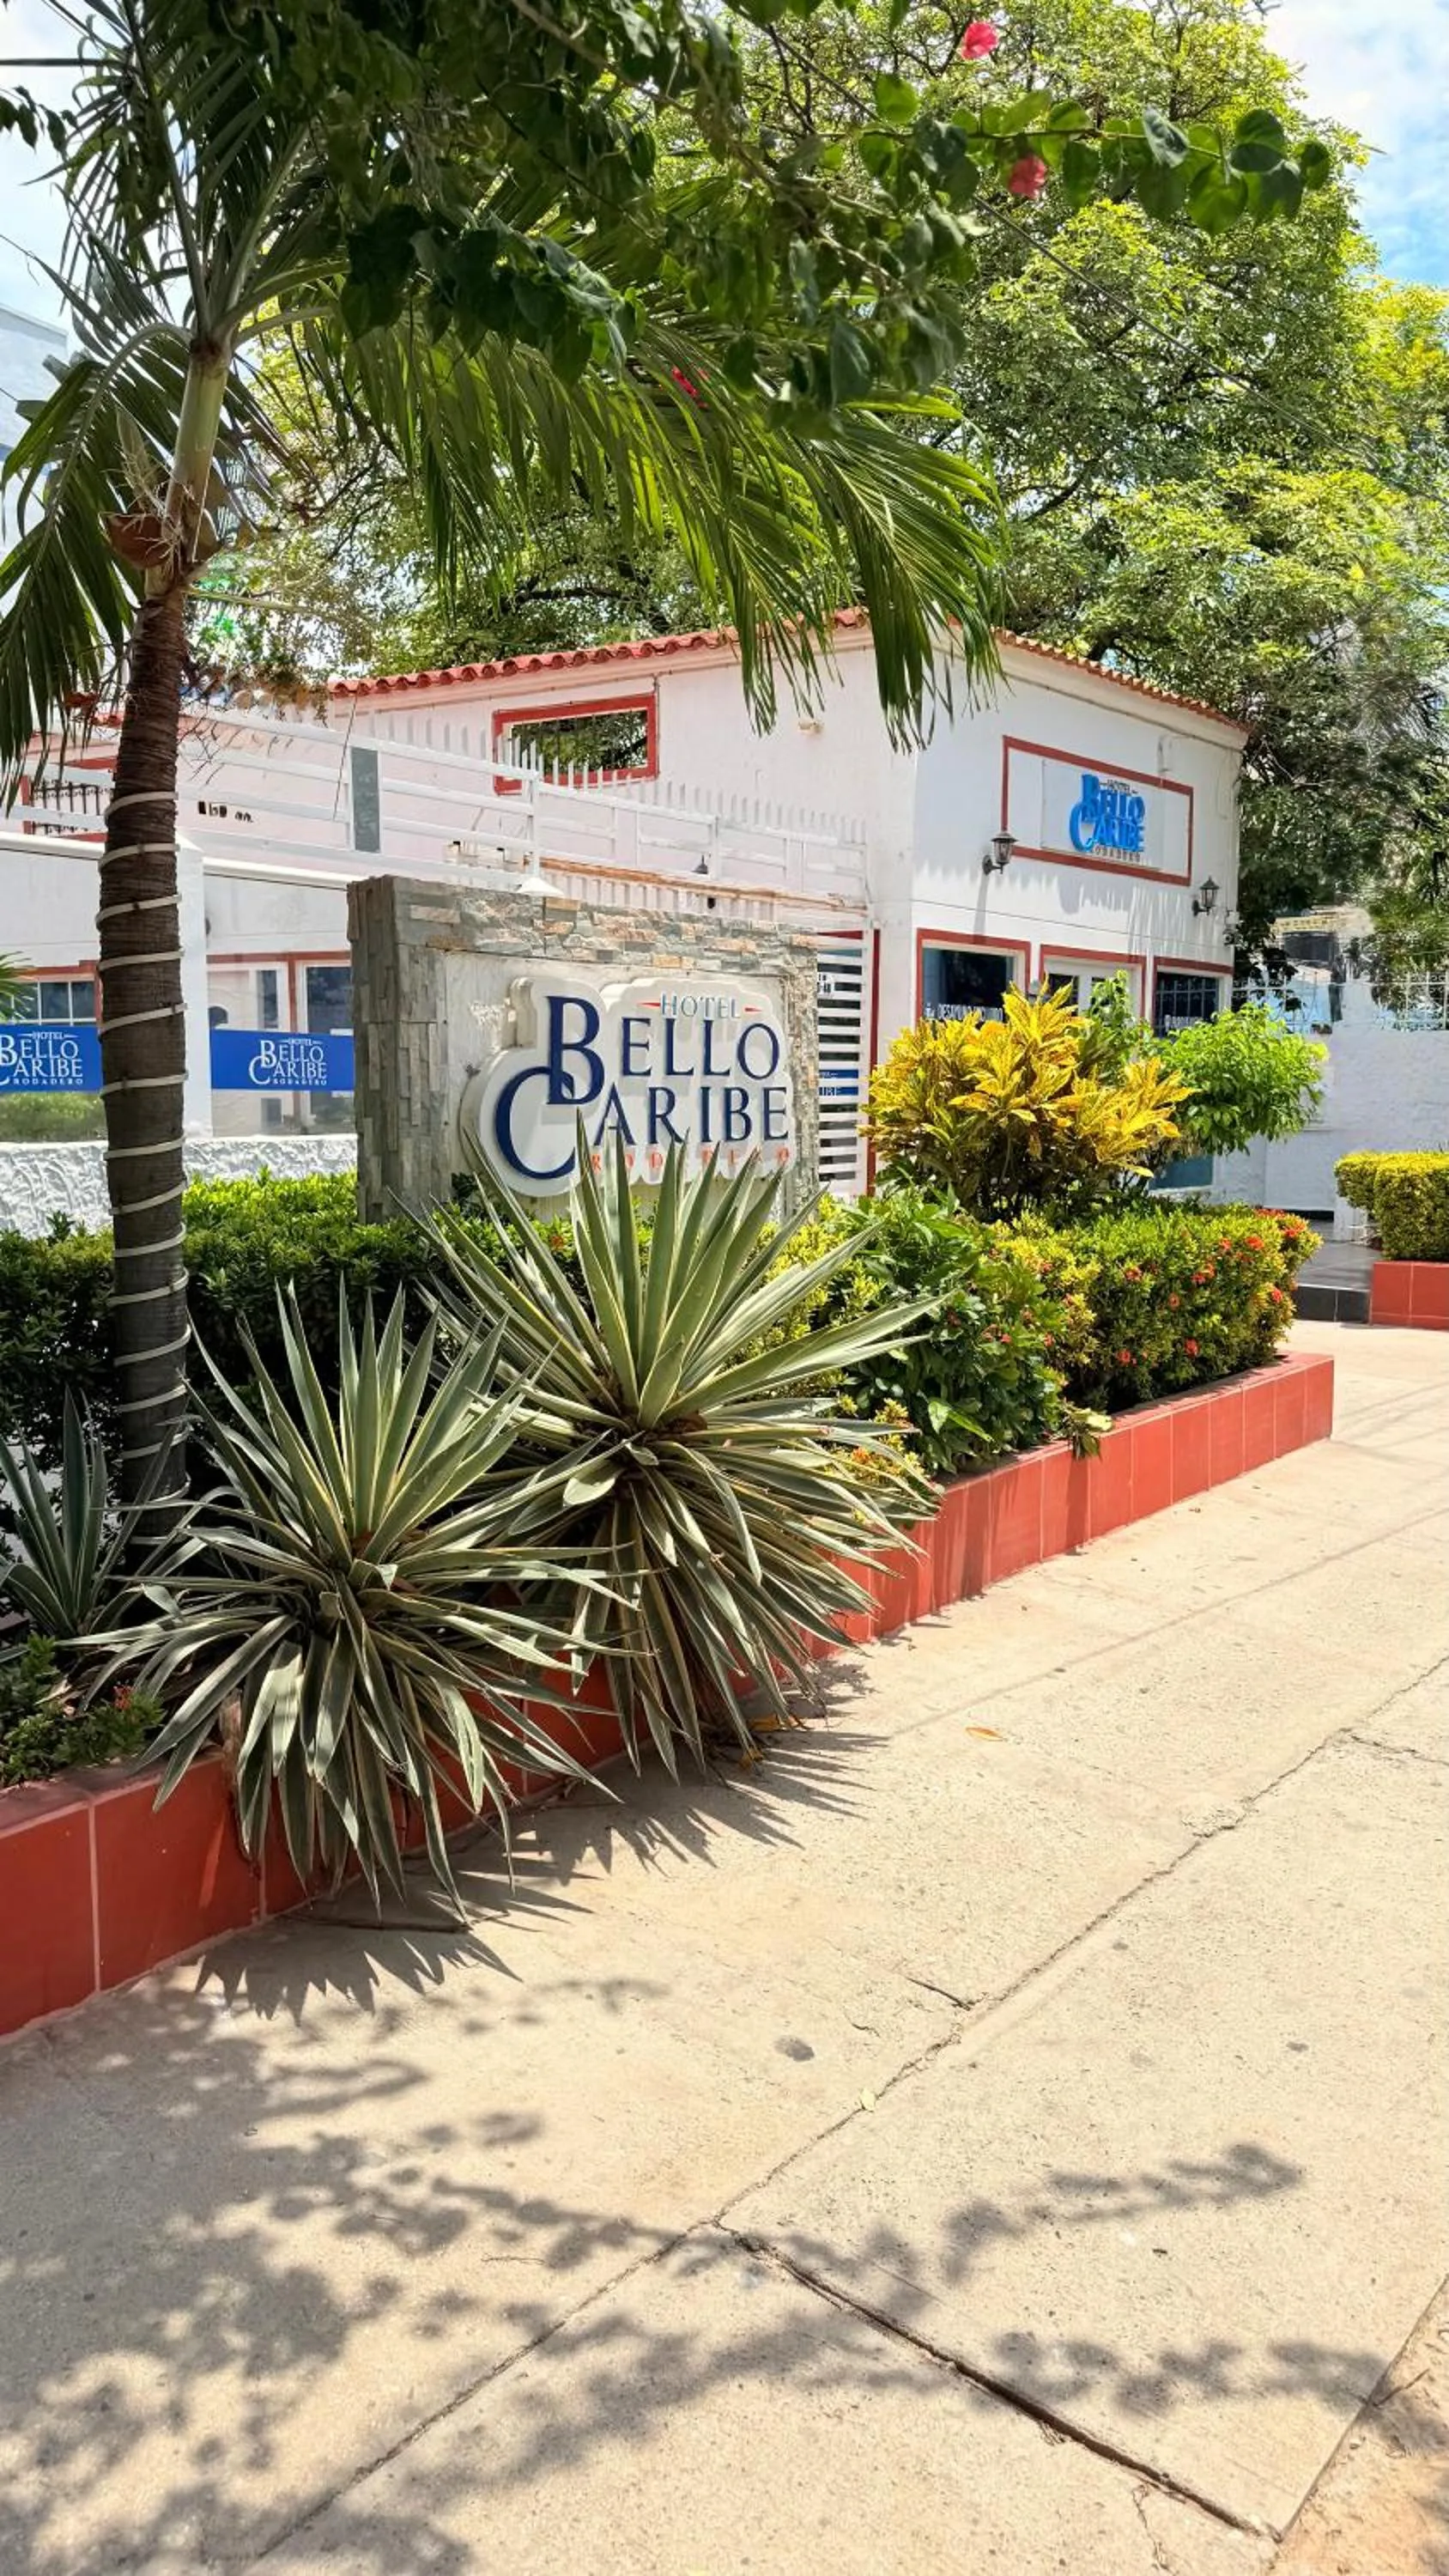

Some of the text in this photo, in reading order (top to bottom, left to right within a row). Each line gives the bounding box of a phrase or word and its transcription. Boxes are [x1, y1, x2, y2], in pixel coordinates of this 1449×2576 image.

[1081, 774, 1145, 824] BELLO
[1070, 802, 1145, 853] CARIBE
[660, 993, 741, 1019] HOTEL
[0, 1035, 79, 1066] BELLO
[32, 1031, 64, 1040] HOTEL
[547, 996, 780, 1105] BELLO
[260, 1040, 324, 1068] BELLO
[0, 1057, 83, 1085] ARIBE
[248, 1055, 328, 1085] CARIBE
[495, 1066, 790, 1180] CARIBE
